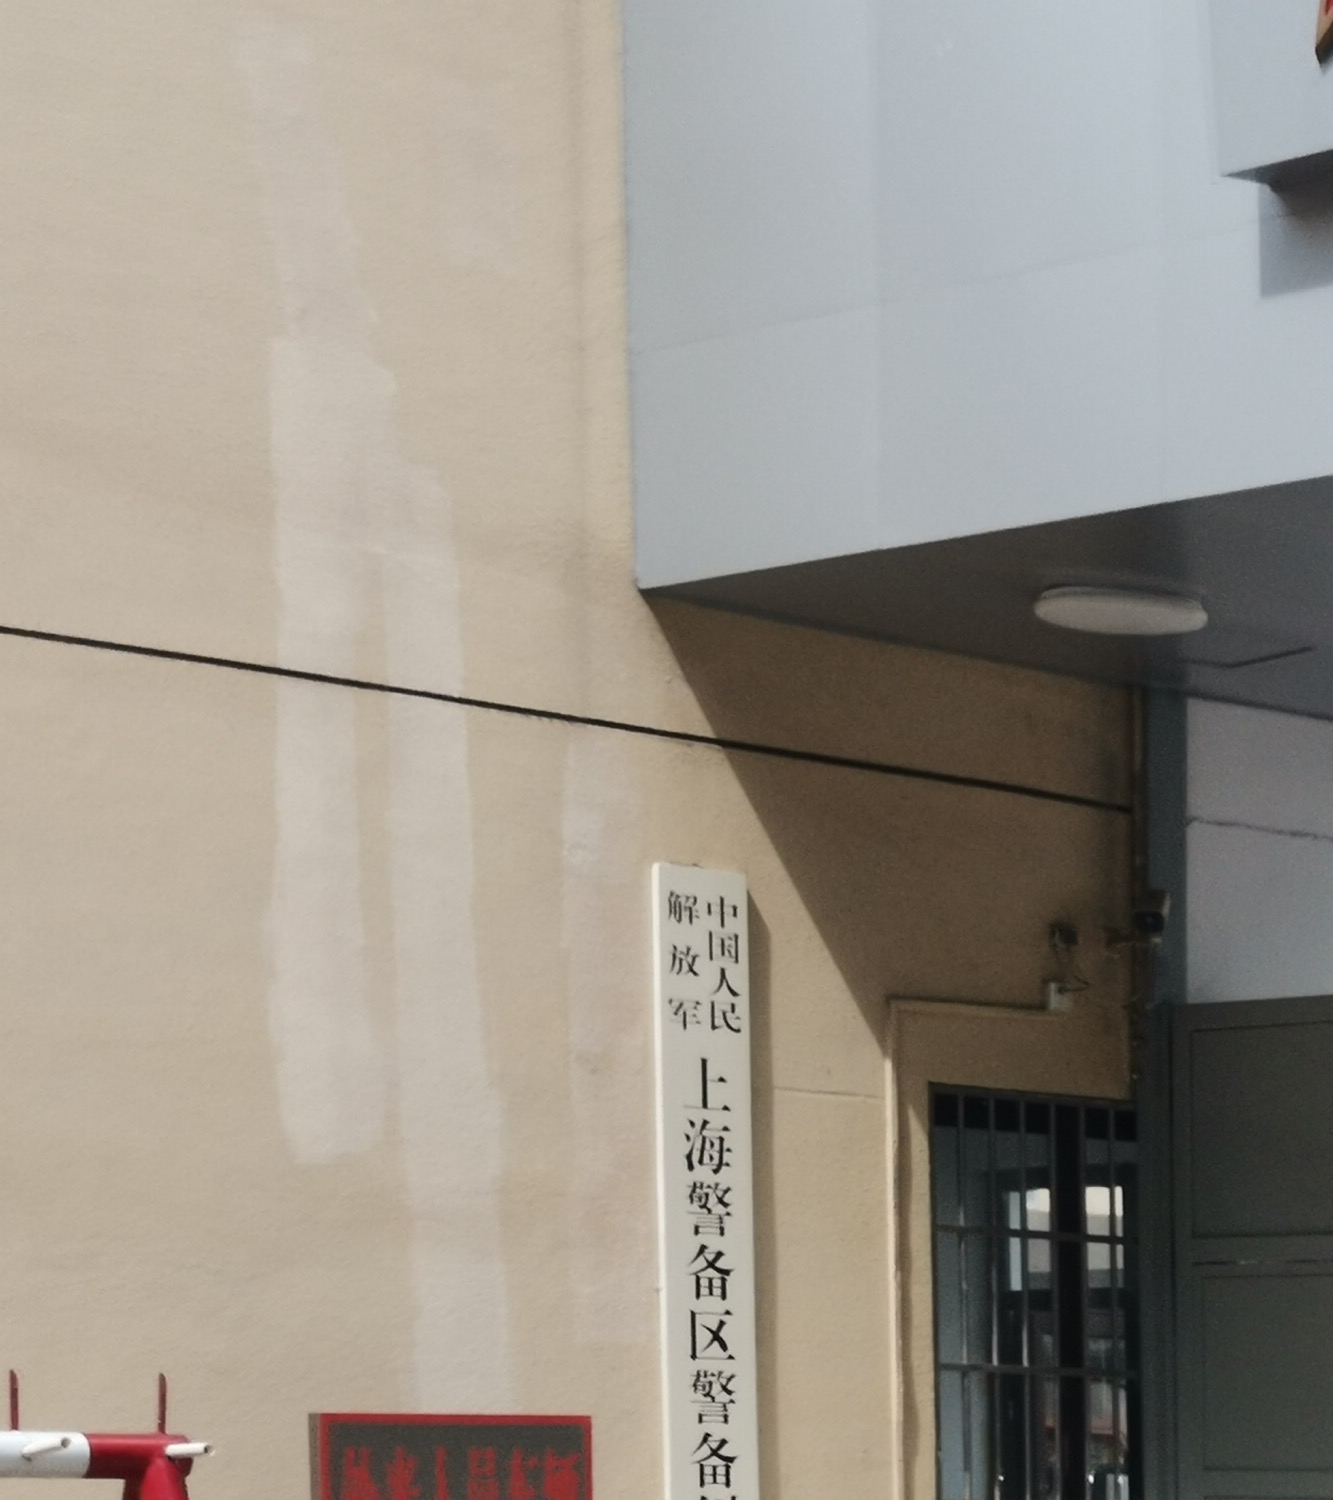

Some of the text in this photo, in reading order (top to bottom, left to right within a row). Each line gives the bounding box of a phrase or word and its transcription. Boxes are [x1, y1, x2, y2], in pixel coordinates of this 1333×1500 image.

[667, 890, 702, 1031] 解放军
[706, 895, 742, 1034] 中国人民
